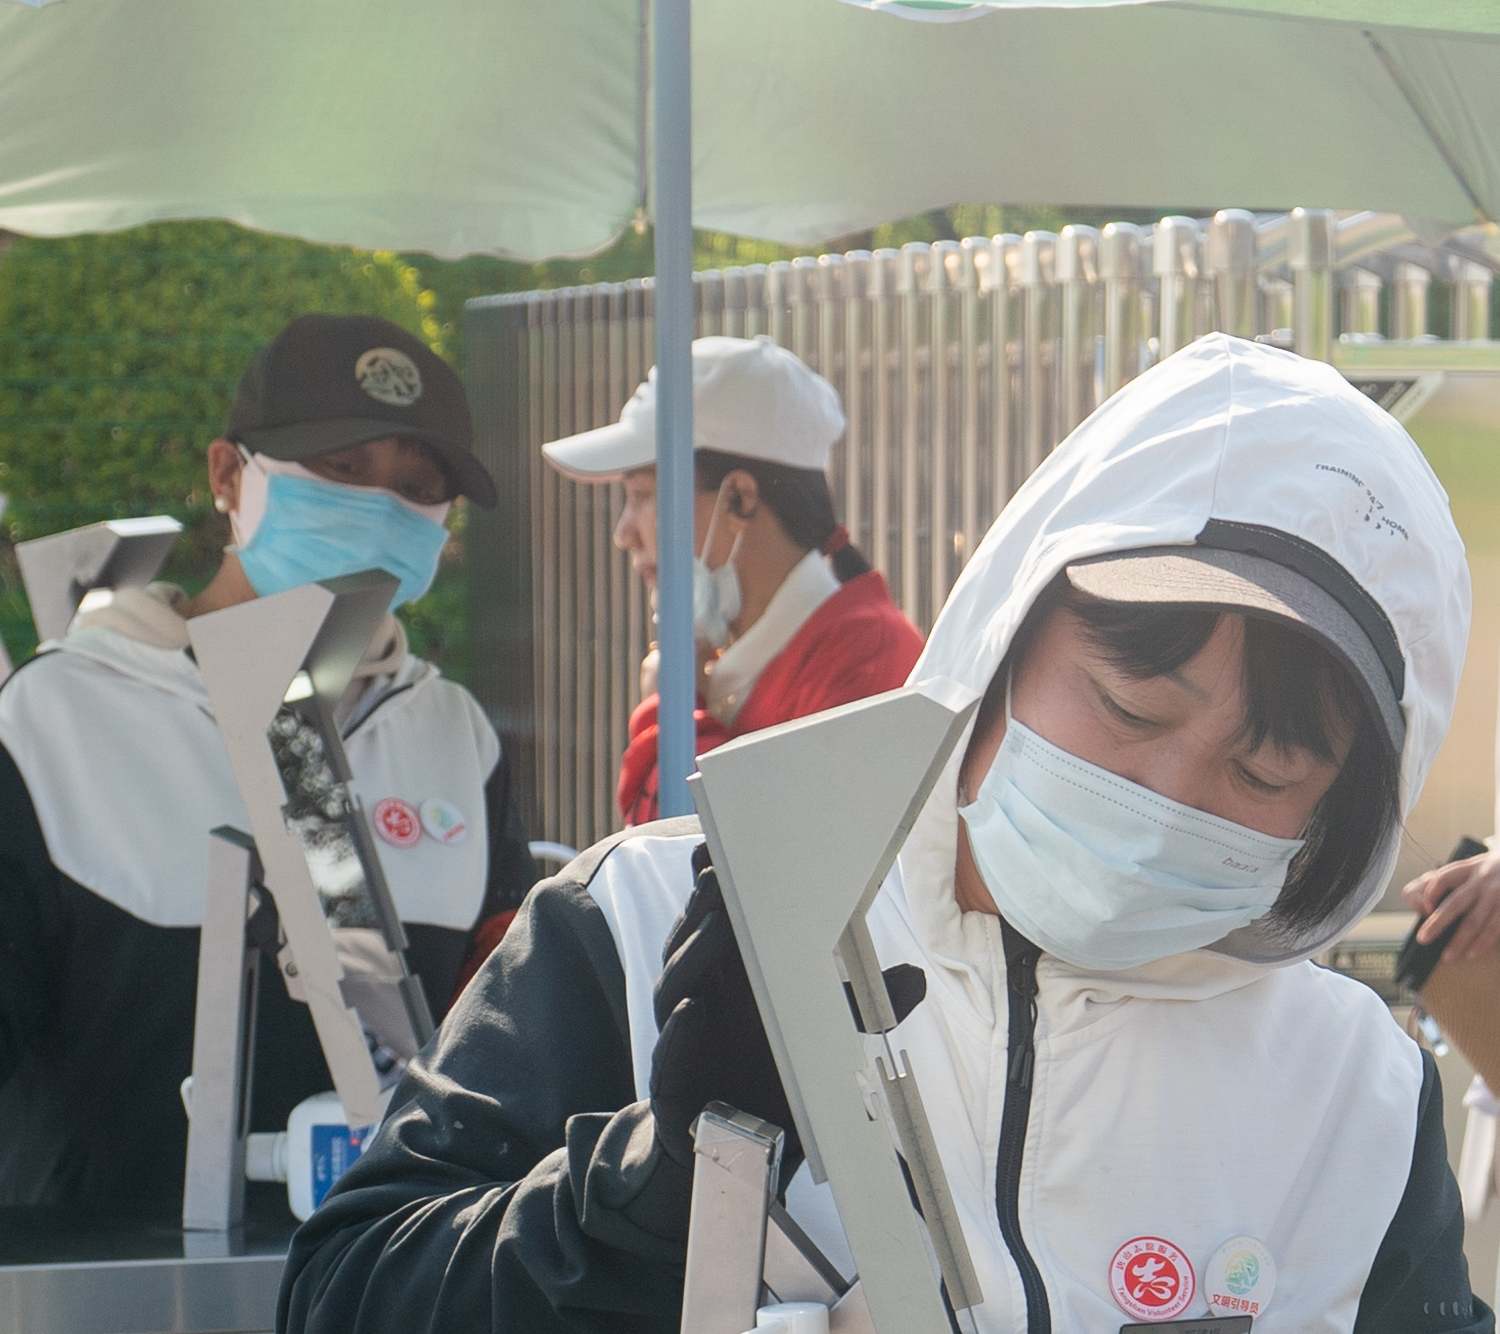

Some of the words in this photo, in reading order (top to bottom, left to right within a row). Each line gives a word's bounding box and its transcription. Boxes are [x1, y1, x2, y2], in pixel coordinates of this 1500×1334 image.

[1208, 1293, 1260, 1315] 文明引导员
